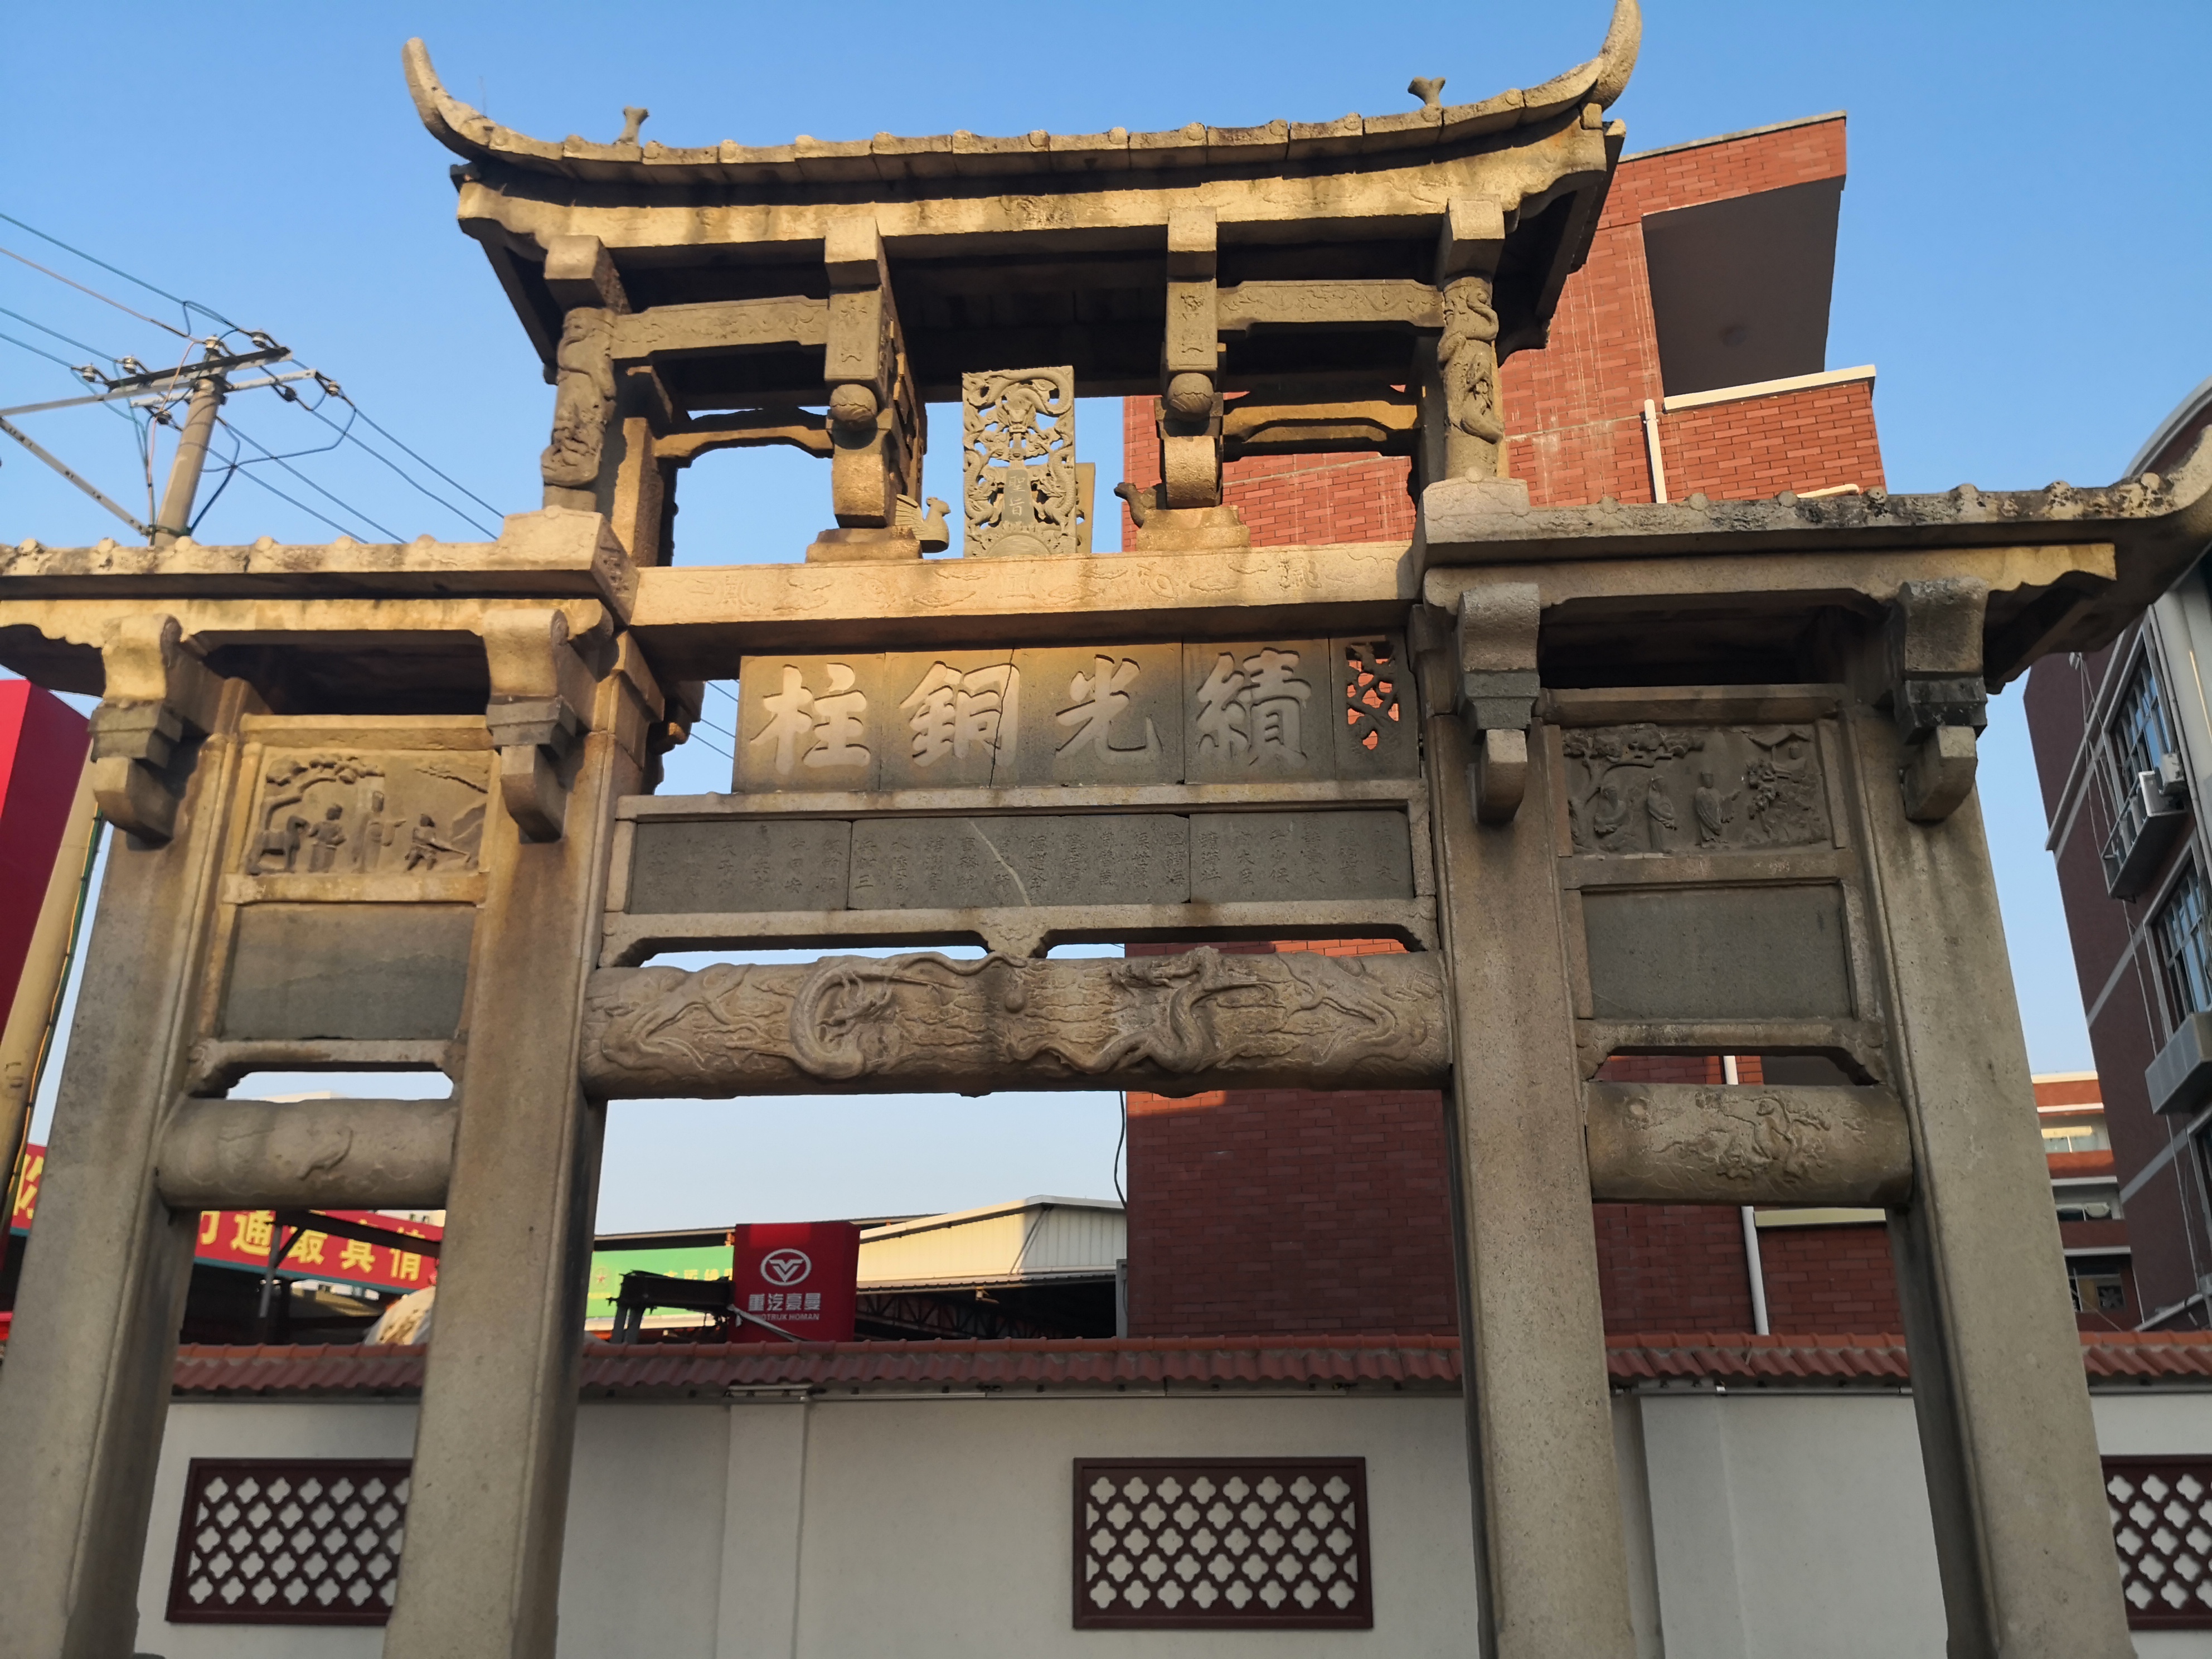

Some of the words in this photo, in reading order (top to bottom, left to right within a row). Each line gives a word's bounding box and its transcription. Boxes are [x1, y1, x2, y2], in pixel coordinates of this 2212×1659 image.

[1008, 475, 1026, 517] 聖旨
[748, 1293, 821, 1311] 重汽豪曼
